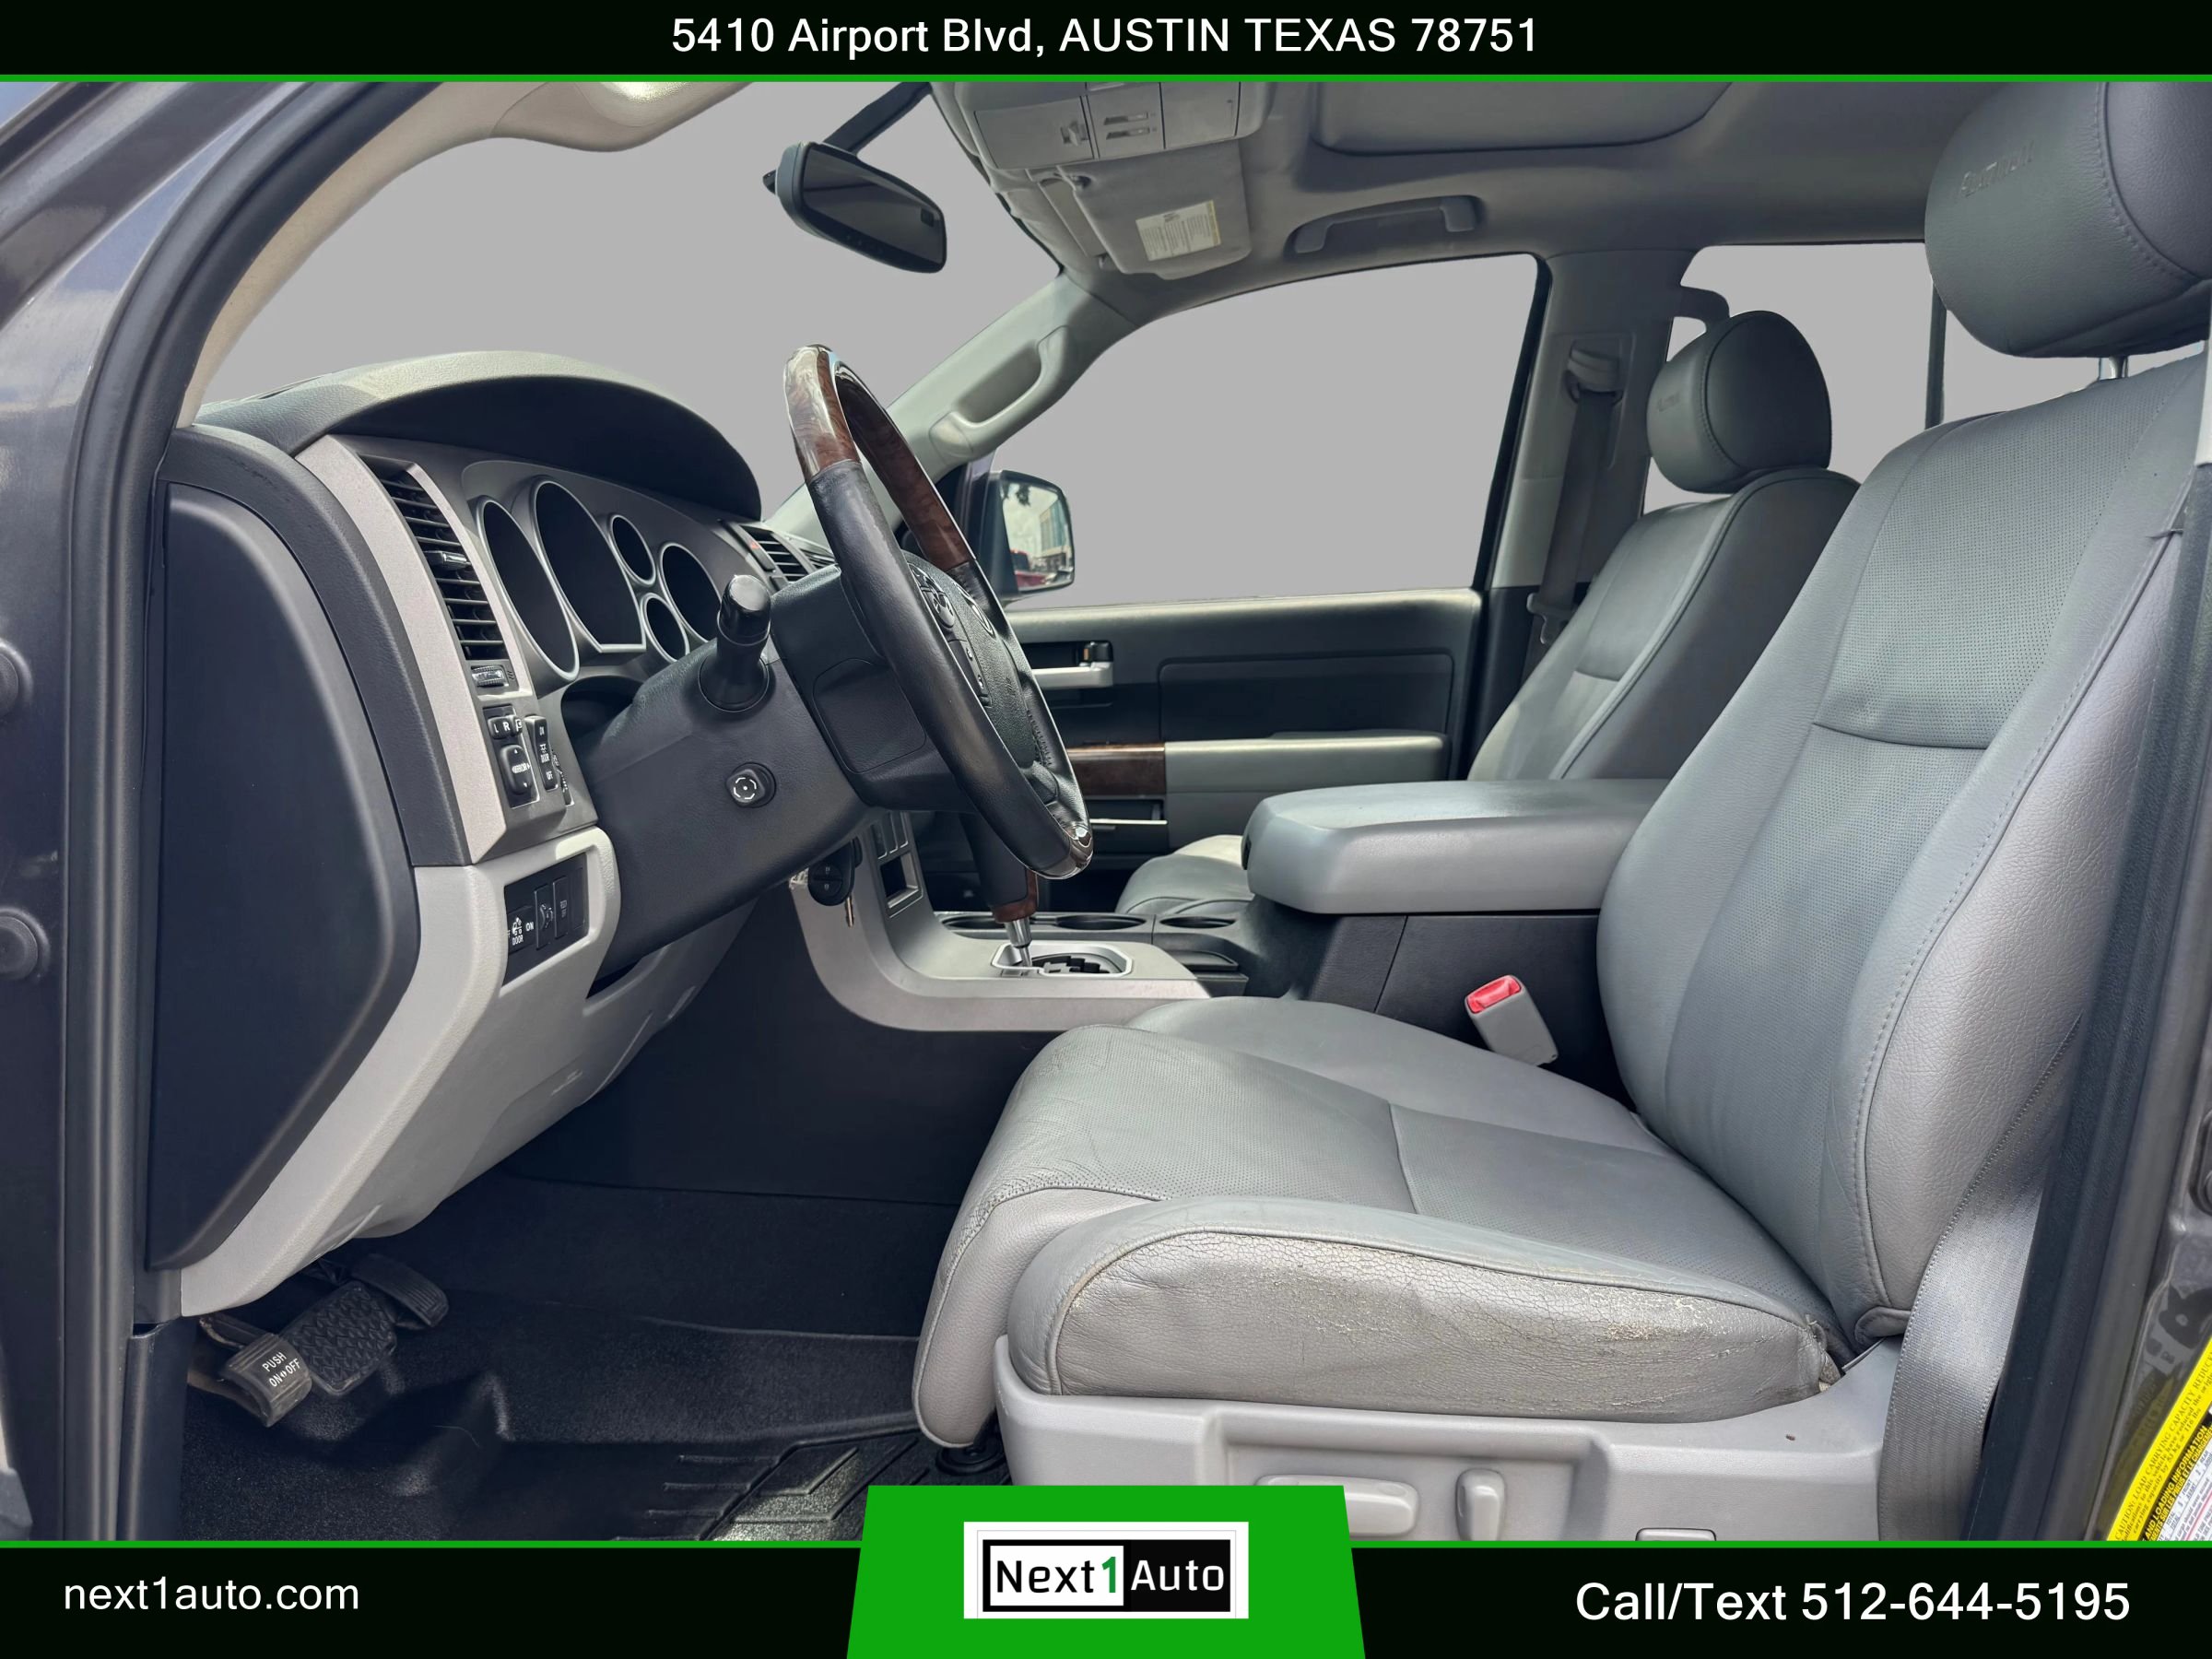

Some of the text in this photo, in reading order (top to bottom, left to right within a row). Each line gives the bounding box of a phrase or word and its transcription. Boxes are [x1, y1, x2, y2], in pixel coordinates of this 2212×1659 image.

[512, 935, 524, 946] DOOR
[525, 922, 535, 932] ON
[262, 1351, 287, 1372] PUSH
[2114, 1494, 2136, 1540] CAUTION:
[2134, 1476, 2147, 1499] LOAD
[2145, 1431, 2171, 1475] CARRYING
[2169, 1392, 2196, 1431] CAPACITY
[2145, 1522, 2158, 1539] AND
[2155, 1483, 2176, 1521] LOADING
[2171, 1425, 2208, 1482] INFORMATION
[2167, 1493, 2176, 1507] LES
[2172, 1477, 2186, 1497] PNEUS
[2133, 1503, 2149, 1534] carrying
[2147, 1476, 2163, 1503] capacity
